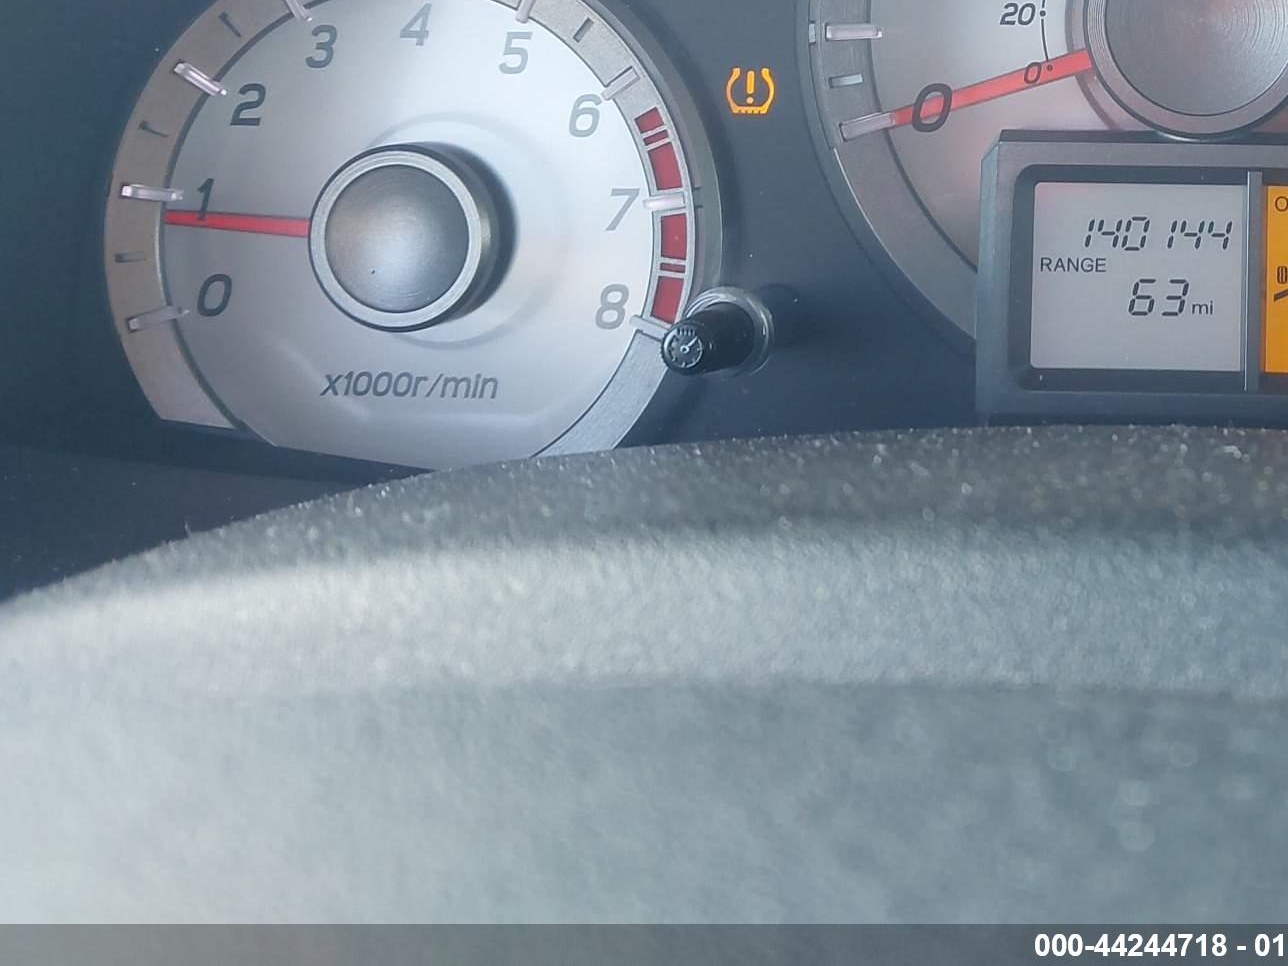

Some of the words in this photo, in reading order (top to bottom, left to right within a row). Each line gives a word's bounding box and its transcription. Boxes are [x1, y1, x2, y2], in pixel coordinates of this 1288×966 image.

[400, 3, 432, 46] 4
[1000, 3, 1035, 25] 20
[305, 25, 337, 68] 3
[499, 32, 533, 74] 5
[1023, 62, 1042, 84] 0
[230, 83, 266, 126] 2
[569, 94, 601, 137] 6
[912, 82, 952, 133] 0
[197, 178, 214, 221] 1
[606, 188, 640, 231] 7
[1085, 217, 1232, 251] 140144
[1041, 257, 1106, 272] RANGE
[197, 274, 232, 317] 0
[596, 284, 629, 329] 8
[1129, 279, 1189, 316] 63
[1192, 301, 1213, 314] mi
[321, 370, 499, 399] x1000r/min
